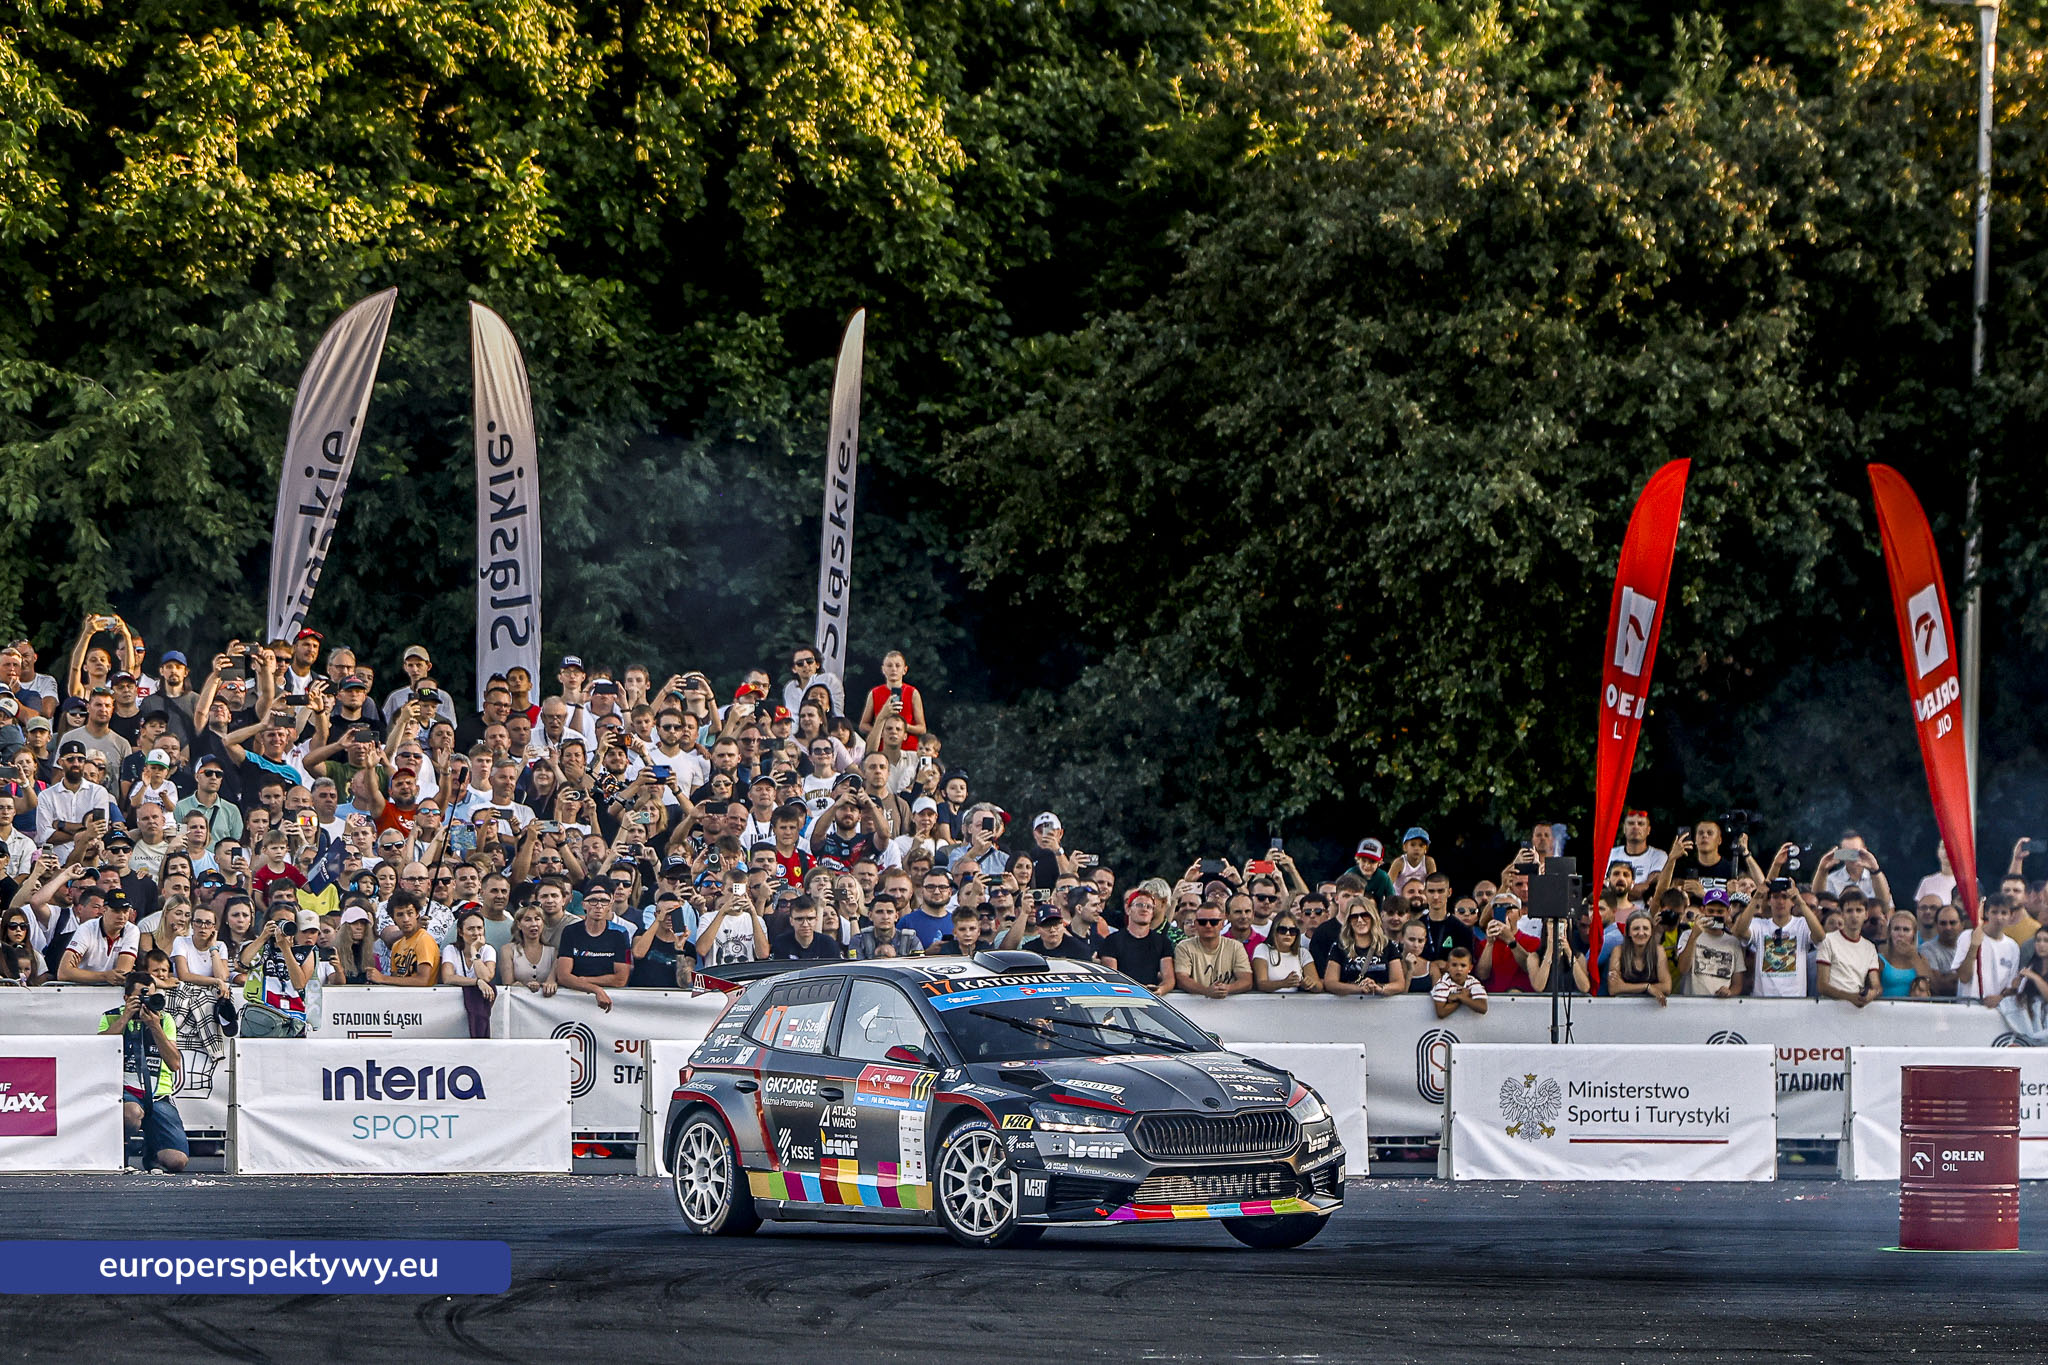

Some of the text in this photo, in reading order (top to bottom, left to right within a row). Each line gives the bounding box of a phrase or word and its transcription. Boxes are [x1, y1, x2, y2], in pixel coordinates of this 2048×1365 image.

[921, 974, 1107, 996] 17 KATOWICE.EU
[1037, 986, 1064, 994] RALLY
[332, 1010, 423, 1030] STADION ŚLĄSKI
[760, 1005, 789, 1041] 17
[797, 1019, 826, 1037] J.Szeja
[791, 1035, 822, 1050] M.Szeja
[1776, 1046, 1846, 1066] upera
[322, 1059, 487, 1101] interia
[765, 1076, 819, 1096] GKFORGE
[915, 1072, 936, 1101] 17
[1568, 1080, 1689, 1099] Ministerstwo
[1776, 1072, 1845, 1092] TADION
[832, 1105, 857, 1117] ATLAS
[1568, 1106, 1730, 1127] Sportu i Turystyki
[352, 1114, 460, 1140] SPORT
[832, 1118, 857, 1129] WARD
[790, 1145, 815, 1160] KSSE
[1941, 1150, 1985, 1161] ORLEN
[1942, 1163, 1959, 1171] OIL
